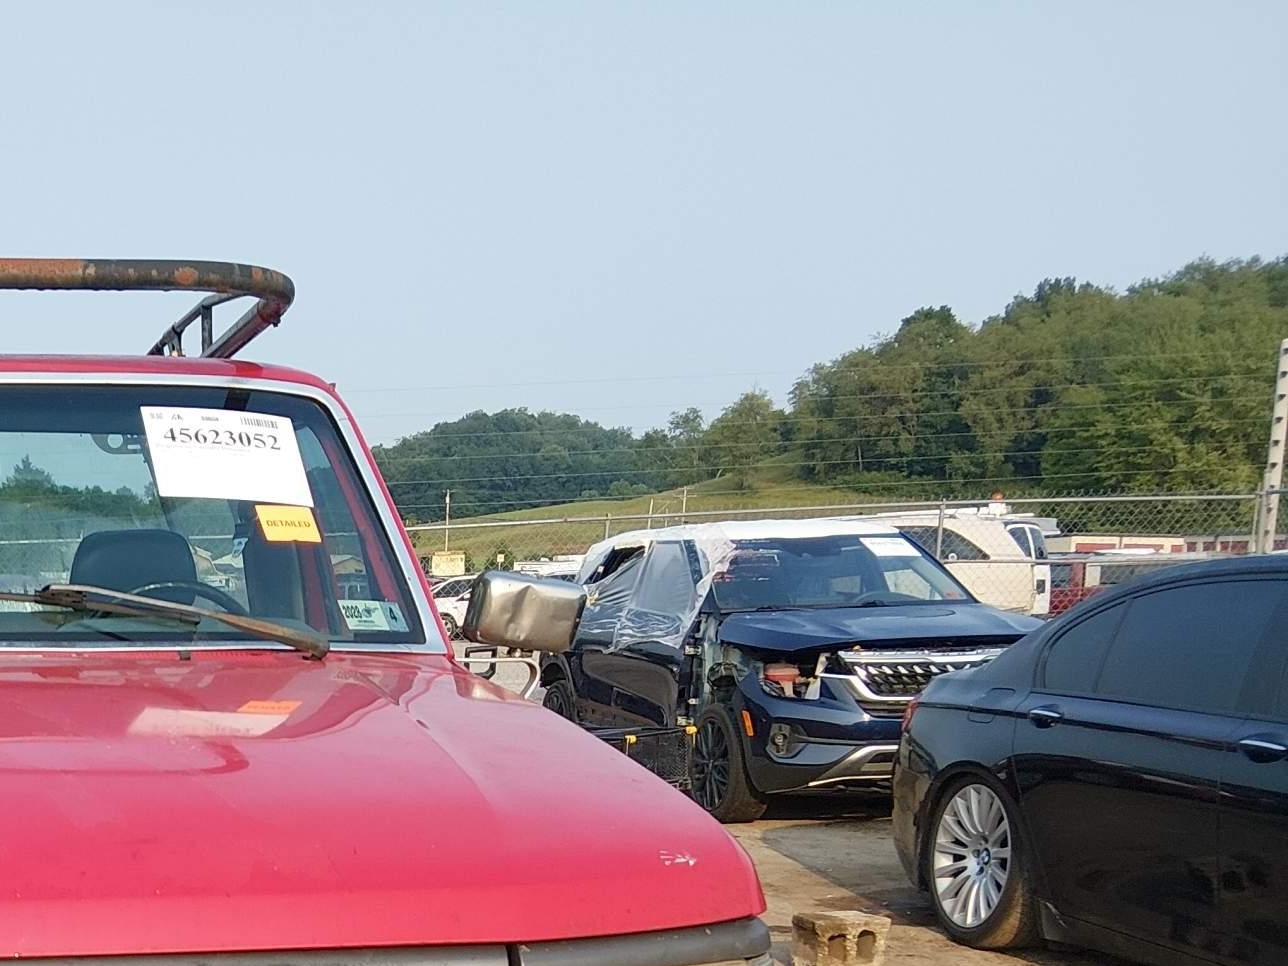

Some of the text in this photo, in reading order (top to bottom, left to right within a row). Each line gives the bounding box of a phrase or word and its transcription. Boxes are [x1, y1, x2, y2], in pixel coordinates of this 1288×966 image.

[163, 427, 281, 450] 45623052
[265, 519, 311, 528] DETAILED
[388, 606, 398, 623] 4
